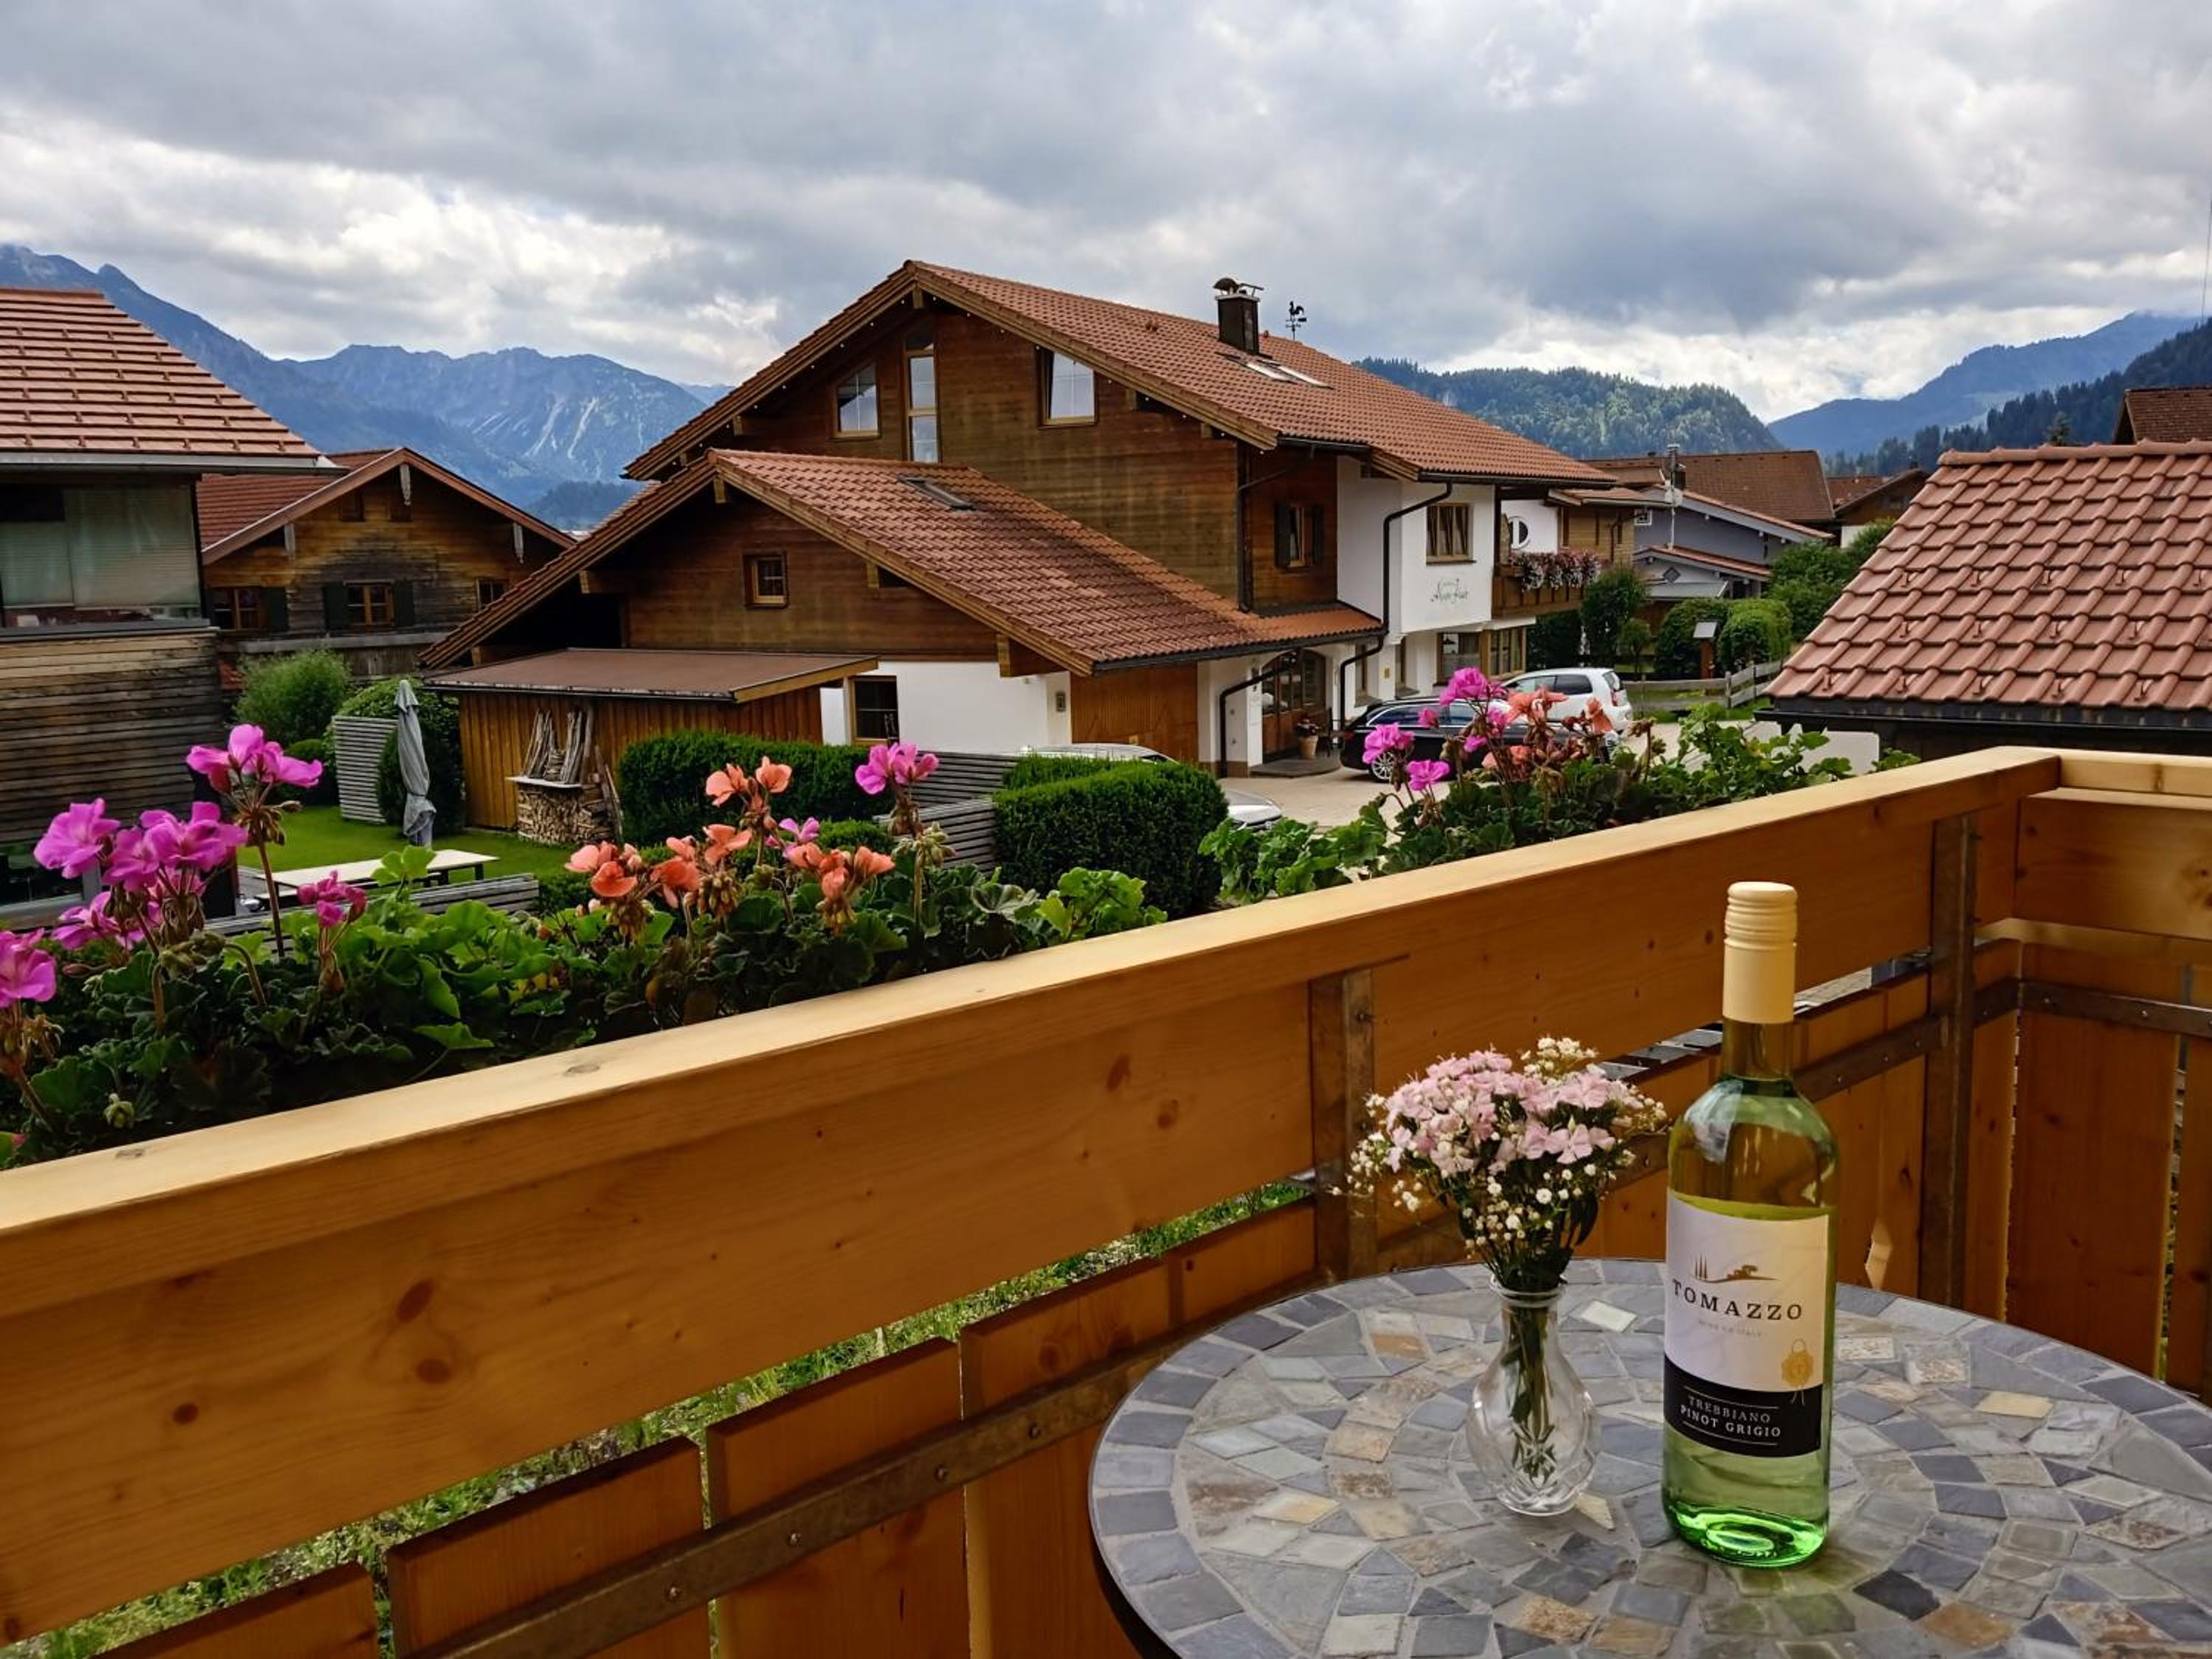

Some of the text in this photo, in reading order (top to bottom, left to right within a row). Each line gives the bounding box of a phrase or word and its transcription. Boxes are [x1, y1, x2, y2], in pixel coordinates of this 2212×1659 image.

[1672, 1278, 1802, 1320] TOMAZZO
[1680, 1404, 1781, 1437] PINOT GRIGIO
[1688, 1395, 1770, 1424] TREBBIANO
